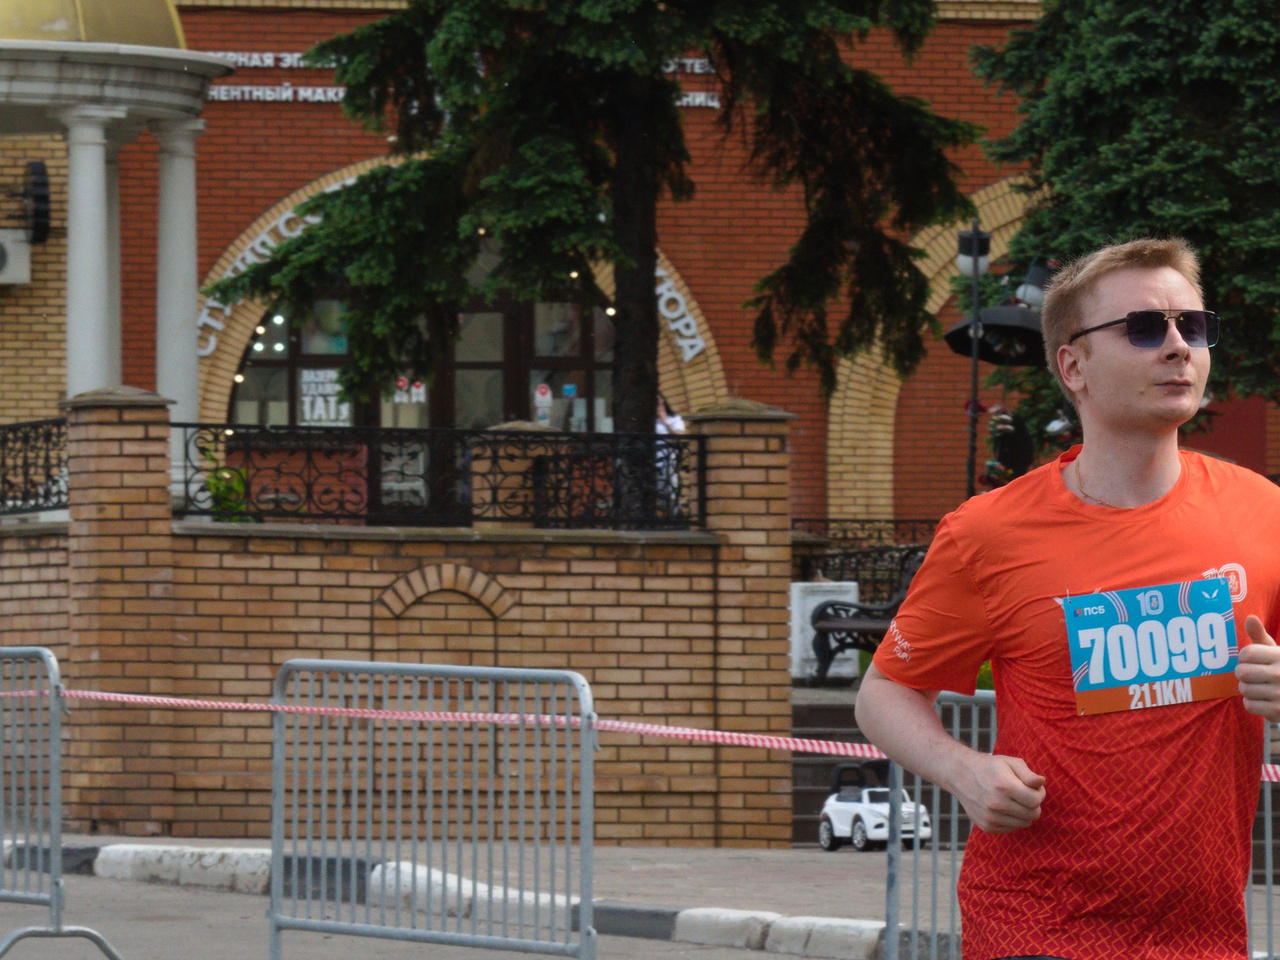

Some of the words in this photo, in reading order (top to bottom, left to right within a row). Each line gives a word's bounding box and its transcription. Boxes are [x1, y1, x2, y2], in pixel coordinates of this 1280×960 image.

[208, 82, 294, 101] НЕНТНЫЙ
[1083, 604, 1106, 617] ПСБ
[1077, 612, 1231, 686] 70099
